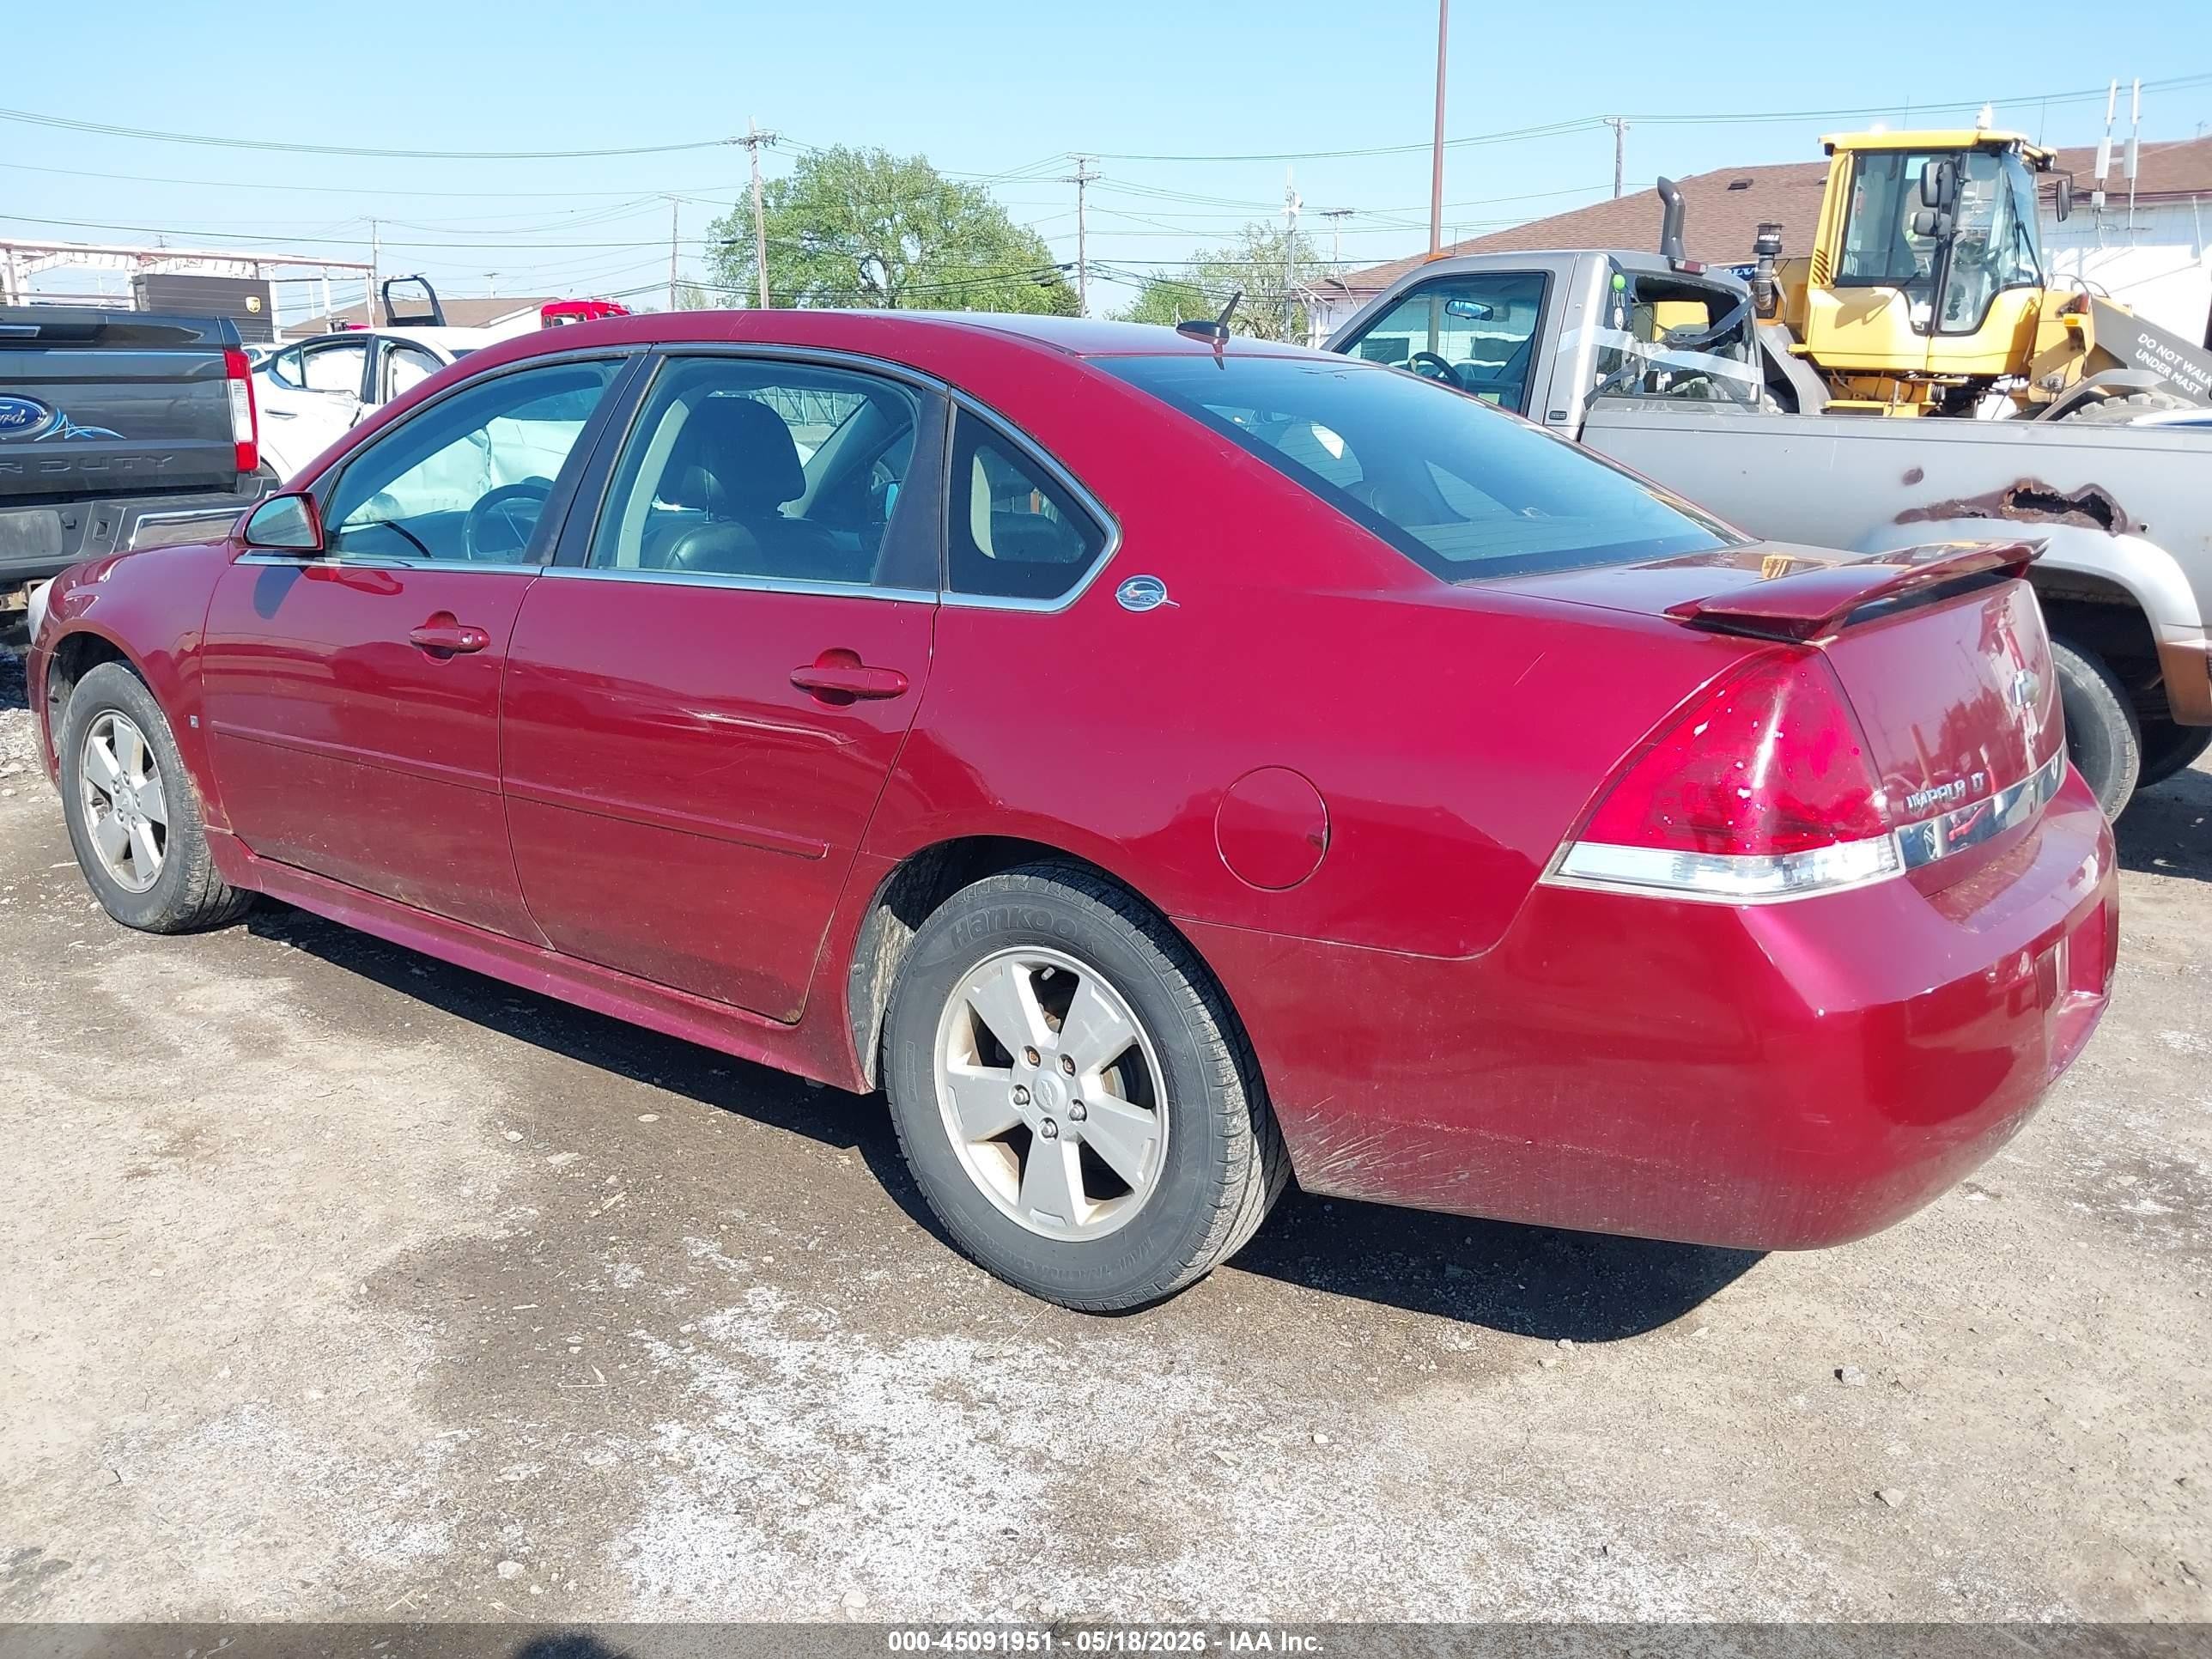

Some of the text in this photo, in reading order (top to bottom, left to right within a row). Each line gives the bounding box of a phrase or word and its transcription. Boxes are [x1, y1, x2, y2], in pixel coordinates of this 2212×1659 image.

[2136, 349, 2203, 395] UNDER MAST
[2137, 332, 2212, 388] DO NOT WALK
[40, 454, 173, 473] DUTY
